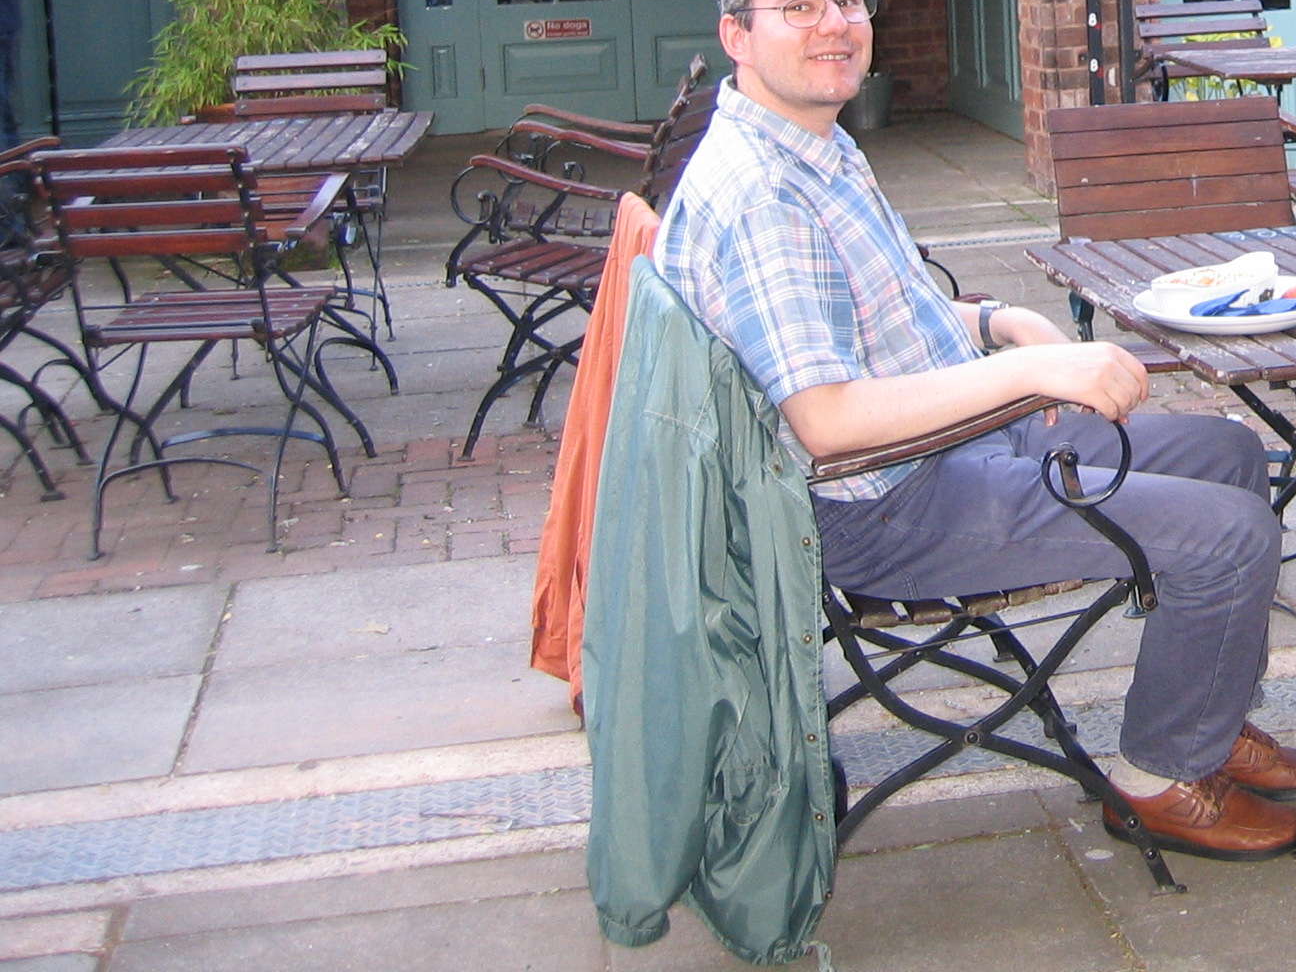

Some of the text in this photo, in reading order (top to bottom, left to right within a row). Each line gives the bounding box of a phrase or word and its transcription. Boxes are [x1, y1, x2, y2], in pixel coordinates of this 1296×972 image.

[563, 21, 587, 30] dogs
[1088, 12, 1097, 27] 8
[1090, 58, 1098, 72] 8
